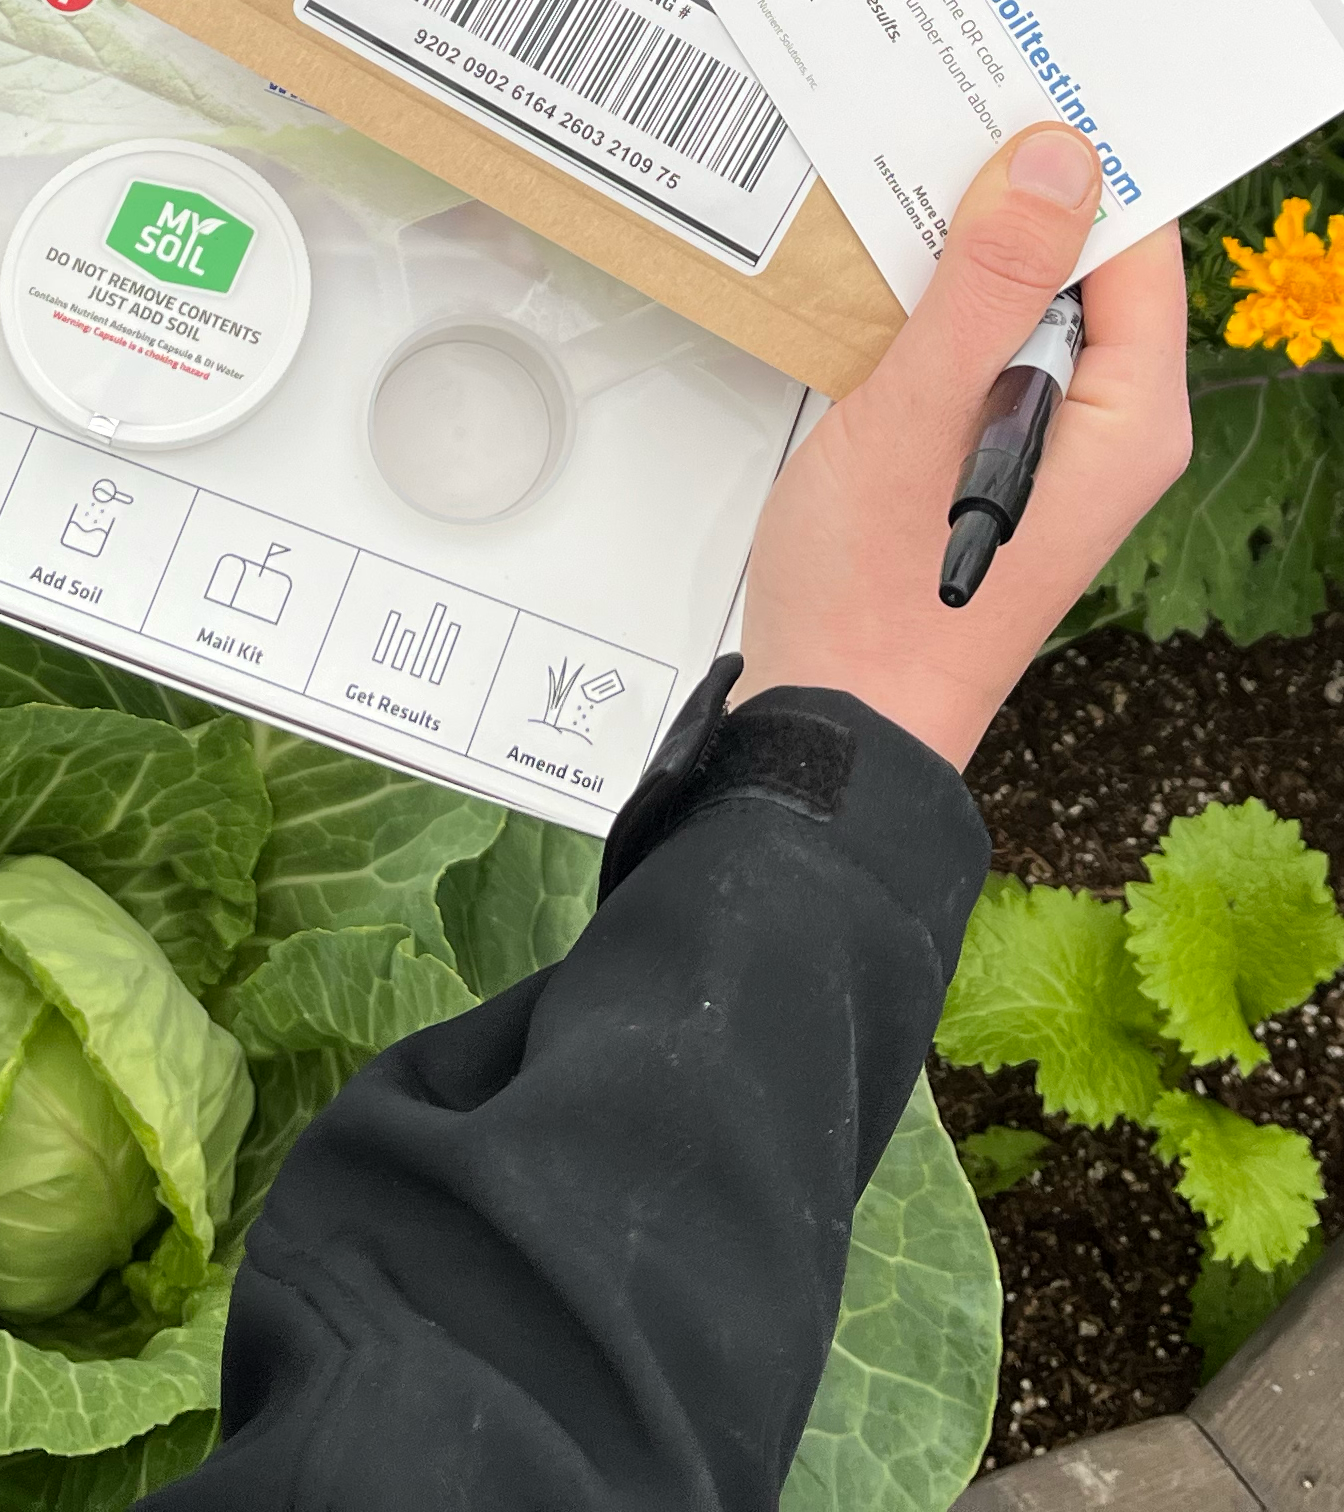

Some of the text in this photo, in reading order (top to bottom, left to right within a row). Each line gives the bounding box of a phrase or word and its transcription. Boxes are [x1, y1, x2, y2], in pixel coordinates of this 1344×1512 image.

[677, 4, 692, 20] #
[778, 32, 808, 77] Solutions,
[960, 18, 984, 46] QR
[976, 45, 1005, 88] code.
[413, 28, 681, 190] 9202 0902 6164 2603 2109 75
[937, 45, 977, 93] found
[967, 92, 1002, 145] above.
[156, 201, 227, 240] MY
[872, 153, 937, 250] Instructions On
[912, 184, 937, 220] More
[932, 217, 953, 242] De
[134, 223, 212, 276] SOIL
[44, 246, 262, 345] DO NOT REMOVE CONTENTS
[86, 284, 200, 342] JUST ADD SOIL
[28, 565, 103, 604] Add Soil
[195, 627, 264, 665] Mail Kit
[345, 683, 441, 732] Get Results
[505, 745, 604, 793] Amend Soil
